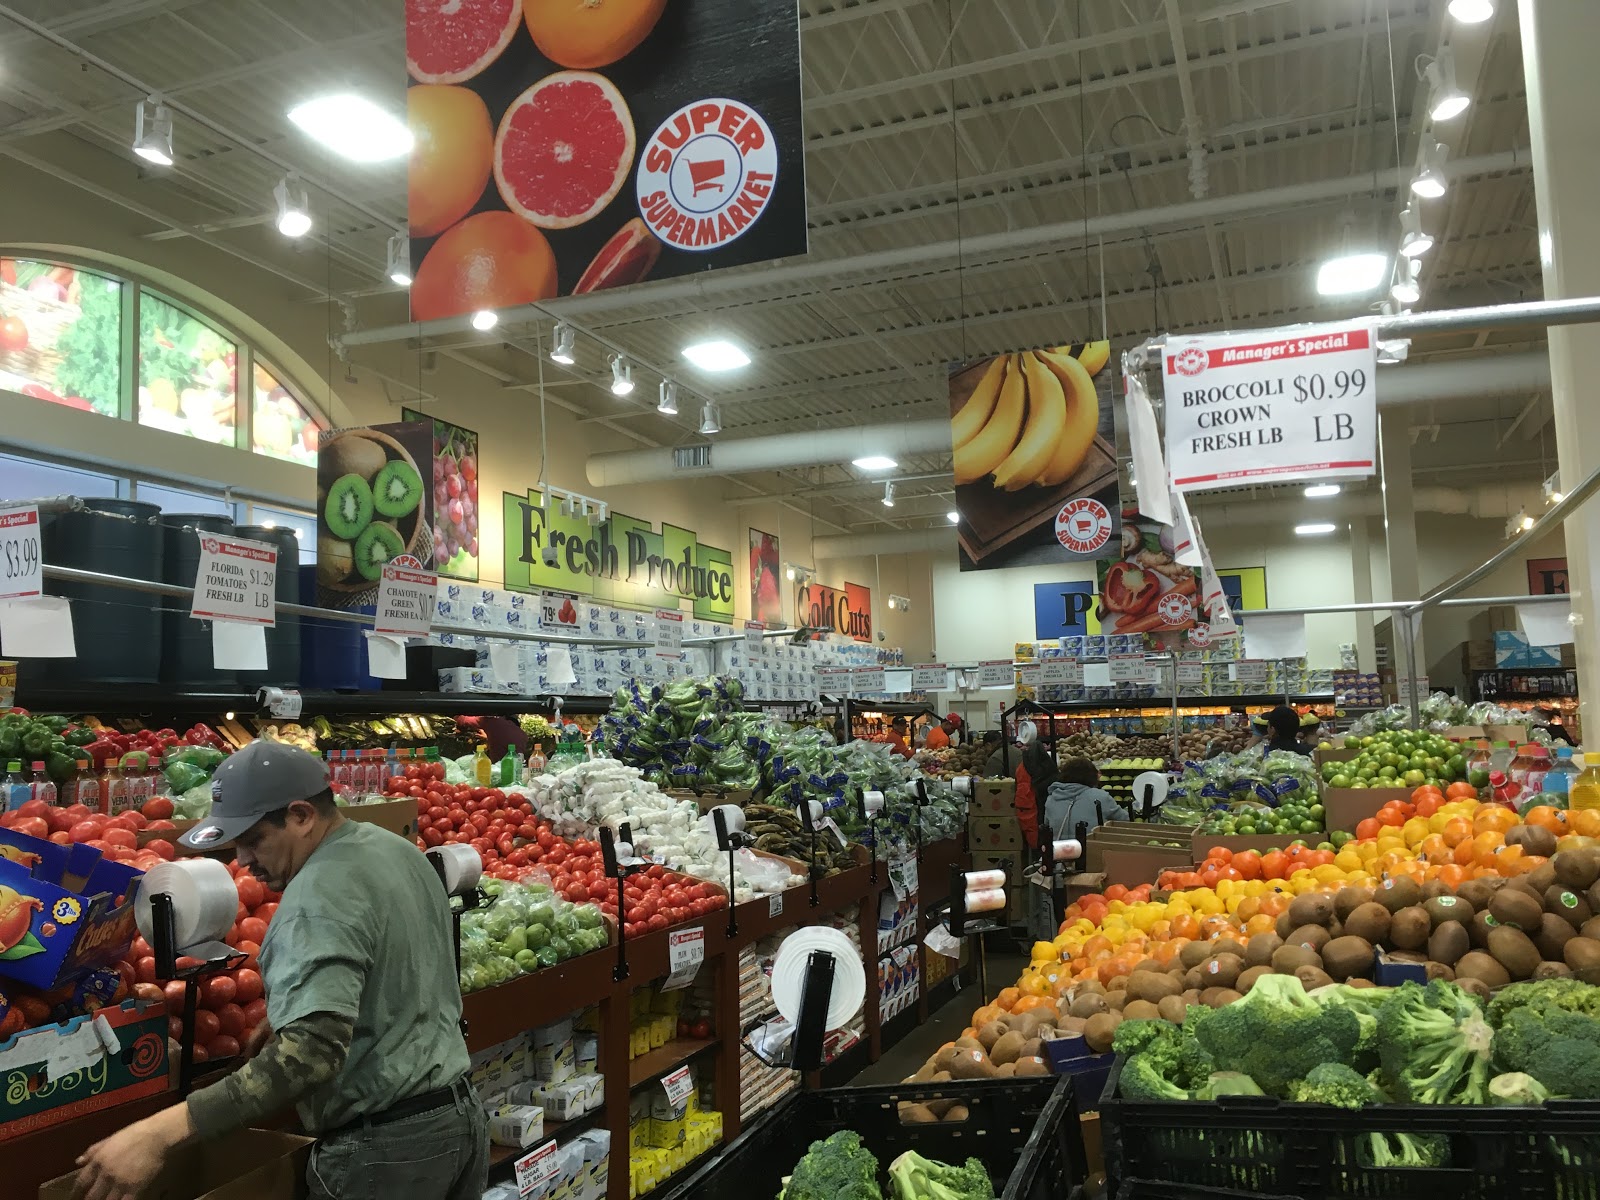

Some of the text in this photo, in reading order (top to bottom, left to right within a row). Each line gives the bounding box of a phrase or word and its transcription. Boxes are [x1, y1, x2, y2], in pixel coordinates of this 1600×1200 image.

[645, 103, 765, 173] SUPER
[640, 170, 774, 247] SUPERMARKET
[1222, 333, 1349, 363] Manager's Special
[1182, 368, 1366, 408] BROCCOLI $0.99
[1197, 404, 1354, 443] CROWN LB
[1191, 427, 1283, 454] FRESH LB
[8, 513, 28, 526] Special
[1058, 499, 1107, 524] SUPER
[1057, 525, 1110, 552] SUPERMARKET
[6, 538, 37, 578] $3.99
[518, 501, 732, 603] Fresh Produce
[205, 574, 247, 590] TOMATOES
[211, 561, 274, 587] FLORIDA $1.29
[206, 589, 269, 608] FRESH LB LB
[386, 587, 418, 598] CHAYOTE
[1160, 594, 1188, 608] SUPER
[391, 599, 414, 608] GREEN
[798, 585, 870, 639] Cold Cuts
[384, 609, 419, 620] FRESH EA
[41, 791, 56, 800] ALOE
[82, 797, 98, 807] VERA
[83, 789, 100, 798] ALOE
[111, 797, 128, 806] VERA
[57, 902, 69, 917] 3
[523, 1167, 540, 1180] SUGAR
